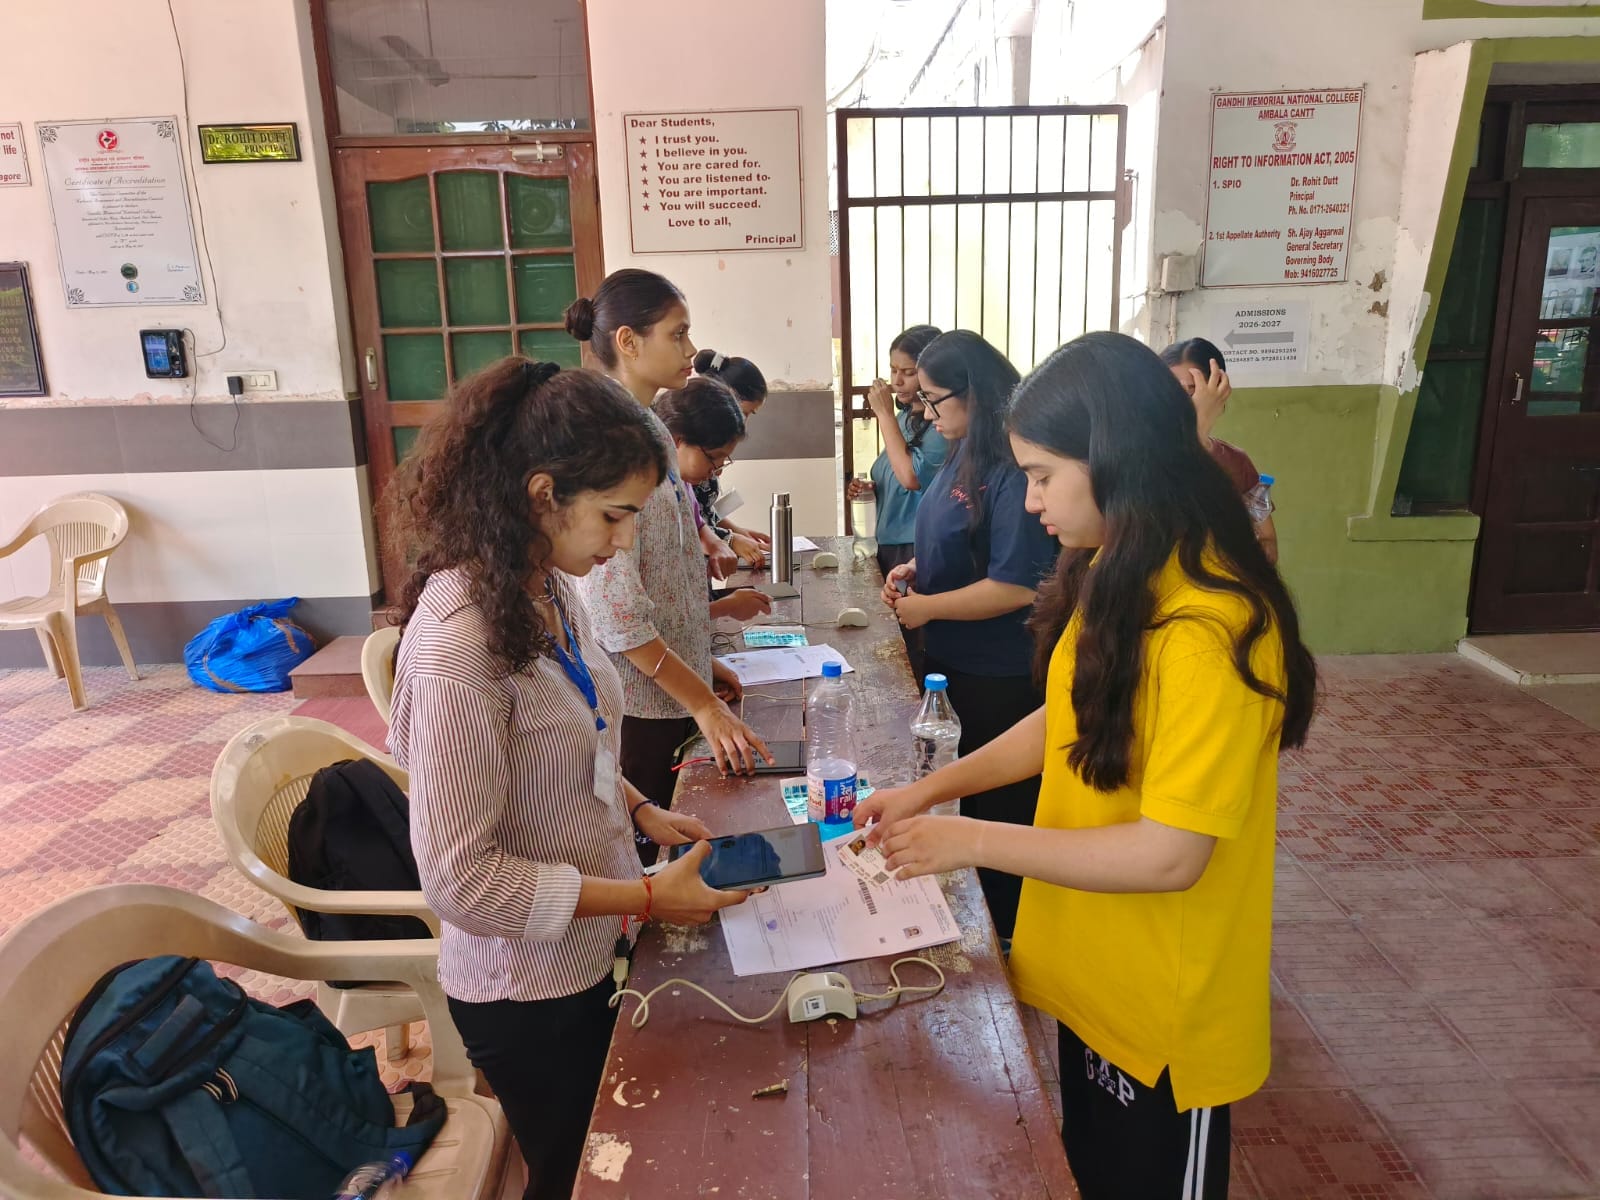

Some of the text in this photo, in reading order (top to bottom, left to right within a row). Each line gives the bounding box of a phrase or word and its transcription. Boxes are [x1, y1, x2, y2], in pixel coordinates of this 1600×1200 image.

[1217, 93, 1359, 107] GANDHI MEMORIAL NATIONAL COLLEGE
[1258, 108, 1315, 119] AMBALA CANTT
[631, 117, 715, 128] Dear Students,
[0, 130, 15, 140] not
[224, 132, 256, 144] ROHIT
[260, 131, 287, 143] DUTT
[655, 135, 720, 145] I trust you.
[3, 145, 17, 155] life
[244, 143, 289, 153] PRINCIPAL
[656, 147, 748, 158] I believe in you.
[657, 159, 761, 171] You are cared for.
[1213, 151, 1355, 168] RIGHT TO INFORMATION ACT, 2005
[0, 173, 22, 182] agore
[64, 176, 103, 187] Certificate
[658, 175, 680, 185] You
[683, 176, 702, 184] are
[705, 173, 753, 184] listened
[1290, 175, 1339, 187] Dr. Rohit Dutt
[1213, 179, 1242, 189] 1. SPIO
[659, 186, 767, 199] You are important.
[1289, 191, 1315, 202] Principal
[659, 200, 761, 212] You will succeed.
[1288, 205, 1298, 215] Ph.
[1299, 205, 1308, 214] No.
[668, 216, 732, 228] Love to all,
[1209, 229, 1281, 241] 2. 1st Appellate Authority
[1287, 226, 1345, 239] Sh. Ajay Aggarwal
[745, 234, 796, 246] Principal
[1286, 240, 1344, 252] General Secretary
[1285, 254, 1334, 267] Governing Body
[1284, 269, 1300, 279] Mob:
[1235, 308, 1287, 317] ADMISSIONS
[1239, 320, 1281, 329] 2026-2027
